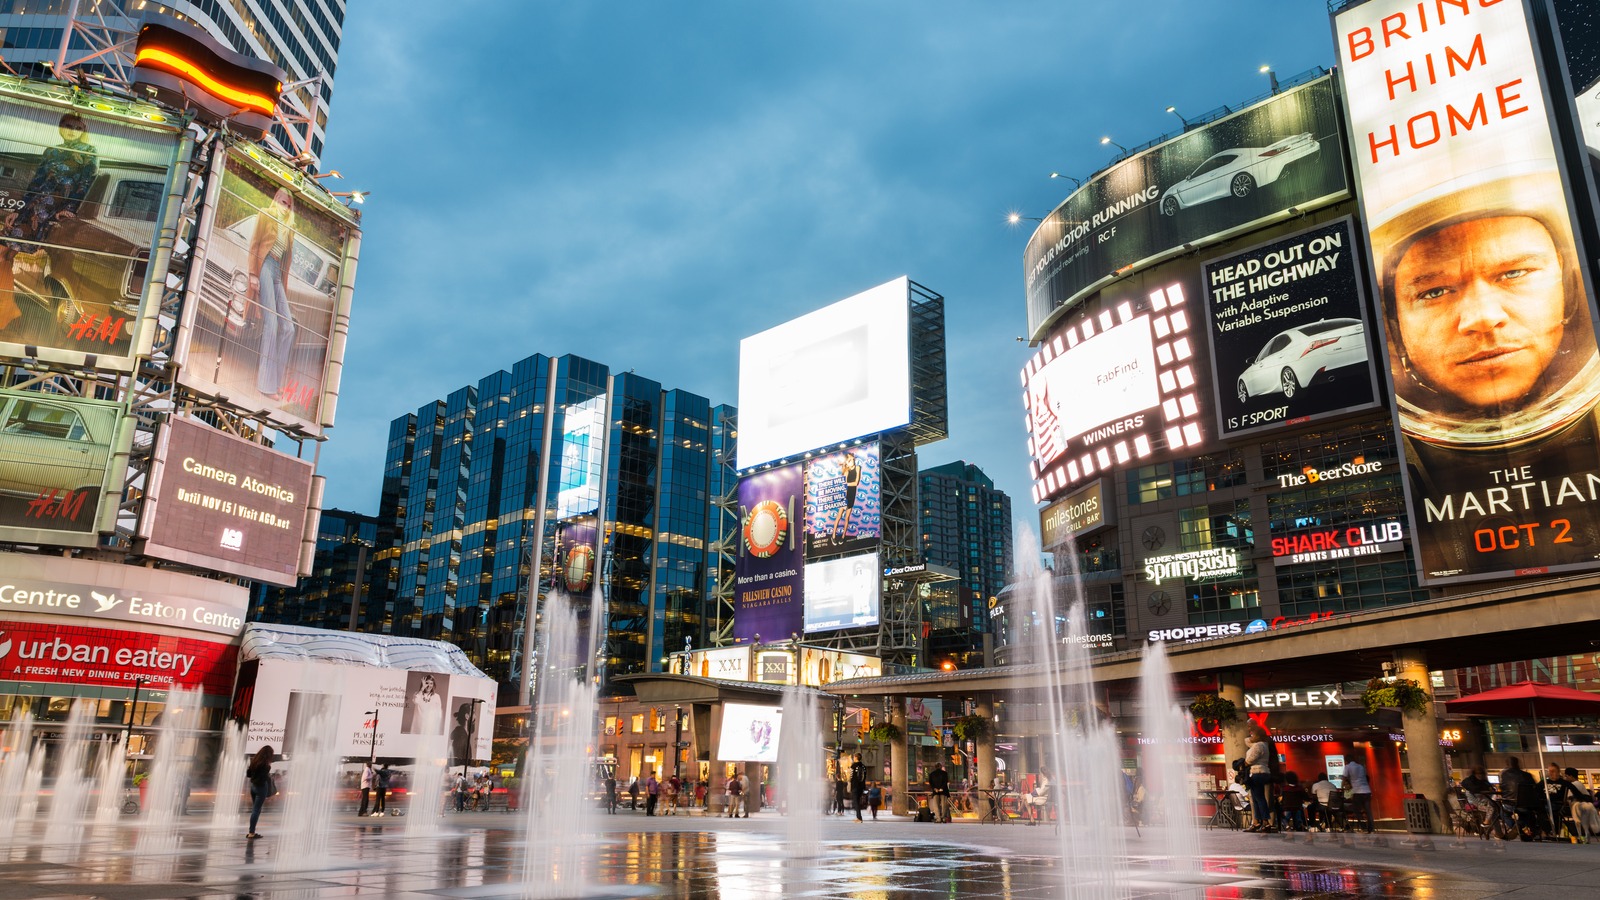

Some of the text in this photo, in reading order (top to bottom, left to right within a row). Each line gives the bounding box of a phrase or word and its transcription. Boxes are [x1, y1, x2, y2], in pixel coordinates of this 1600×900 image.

[1347, 0, 1503, 62] BRIN
[1385, 33, 1487, 100] HIM
[1368, 78, 1528, 164] HOME
[1036, 247, 1055, 275] YOUR
[1055, 220, 1090, 255] MOTOR
[1092, 185, 1160, 229] RUNNING
[1098, 226, 1117, 244] RC F
[1211, 232, 1342, 287] HEAD OUT ON
[1213, 252, 1340, 304] THE HIGHWAY
[1216, 292, 1290, 320] with Adaptive
[1217, 295, 1329, 333] Variable Suspension
[66, 312, 126, 345] H&M
[1097, 357, 1138, 386] FabFind
[279, 377, 314, 411] H&M
[1083, 415, 1144, 446] WINNERS
[1228, 416, 1239, 429] IS
[1241, 414, 1248, 427] F
[1250, 405, 1289, 425] SPORT
[182, 457, 295, 503] Camera Atomica
[1277, 461, 1382, 488] The Beer Store
[1489, 465, 1534, 484] THE
[27, 486, 89, 522] H&M
[177, 488, 290, 530] Until NOV 15 Visit AGO.net
[1046, 496, 1098, 531] milestones
[1066, 513, 1099, 533] GRILL BAR
[1474, 518, 1573, 553] OCT 2
[1271, 521, 1403, 557] SHARK CLUB
[1292, 544, 1381, 563] SPORTS BAR GRILL
[737, 576, 754, 584] More
[754, 573, 768, 582] than
[774, 569, 797, 579] casino.
[891, 563, 925, 575] Clear Channel
[0, 585, 241, 630] Centre Eaton Centre
[742, 585, 792, 602] FALLSVIEW CASINO
[742, 597, 791, 609] NIAGARA FALLS
[1062, 633, 1113, 644] milestones
[1148, 622, 1242, 642] SHOPPERS
[18, 637, 196, 677] urban eatery
[719, 658, 742, 672] XXI
[765, 662, 786, 671] XXI
[13, 665, 174, 684] A FRESH NEW DINING EXPERIENCE
[1301, 733, 1334, 742] SPORTS
[1443, 730, 1461, 740] AS
